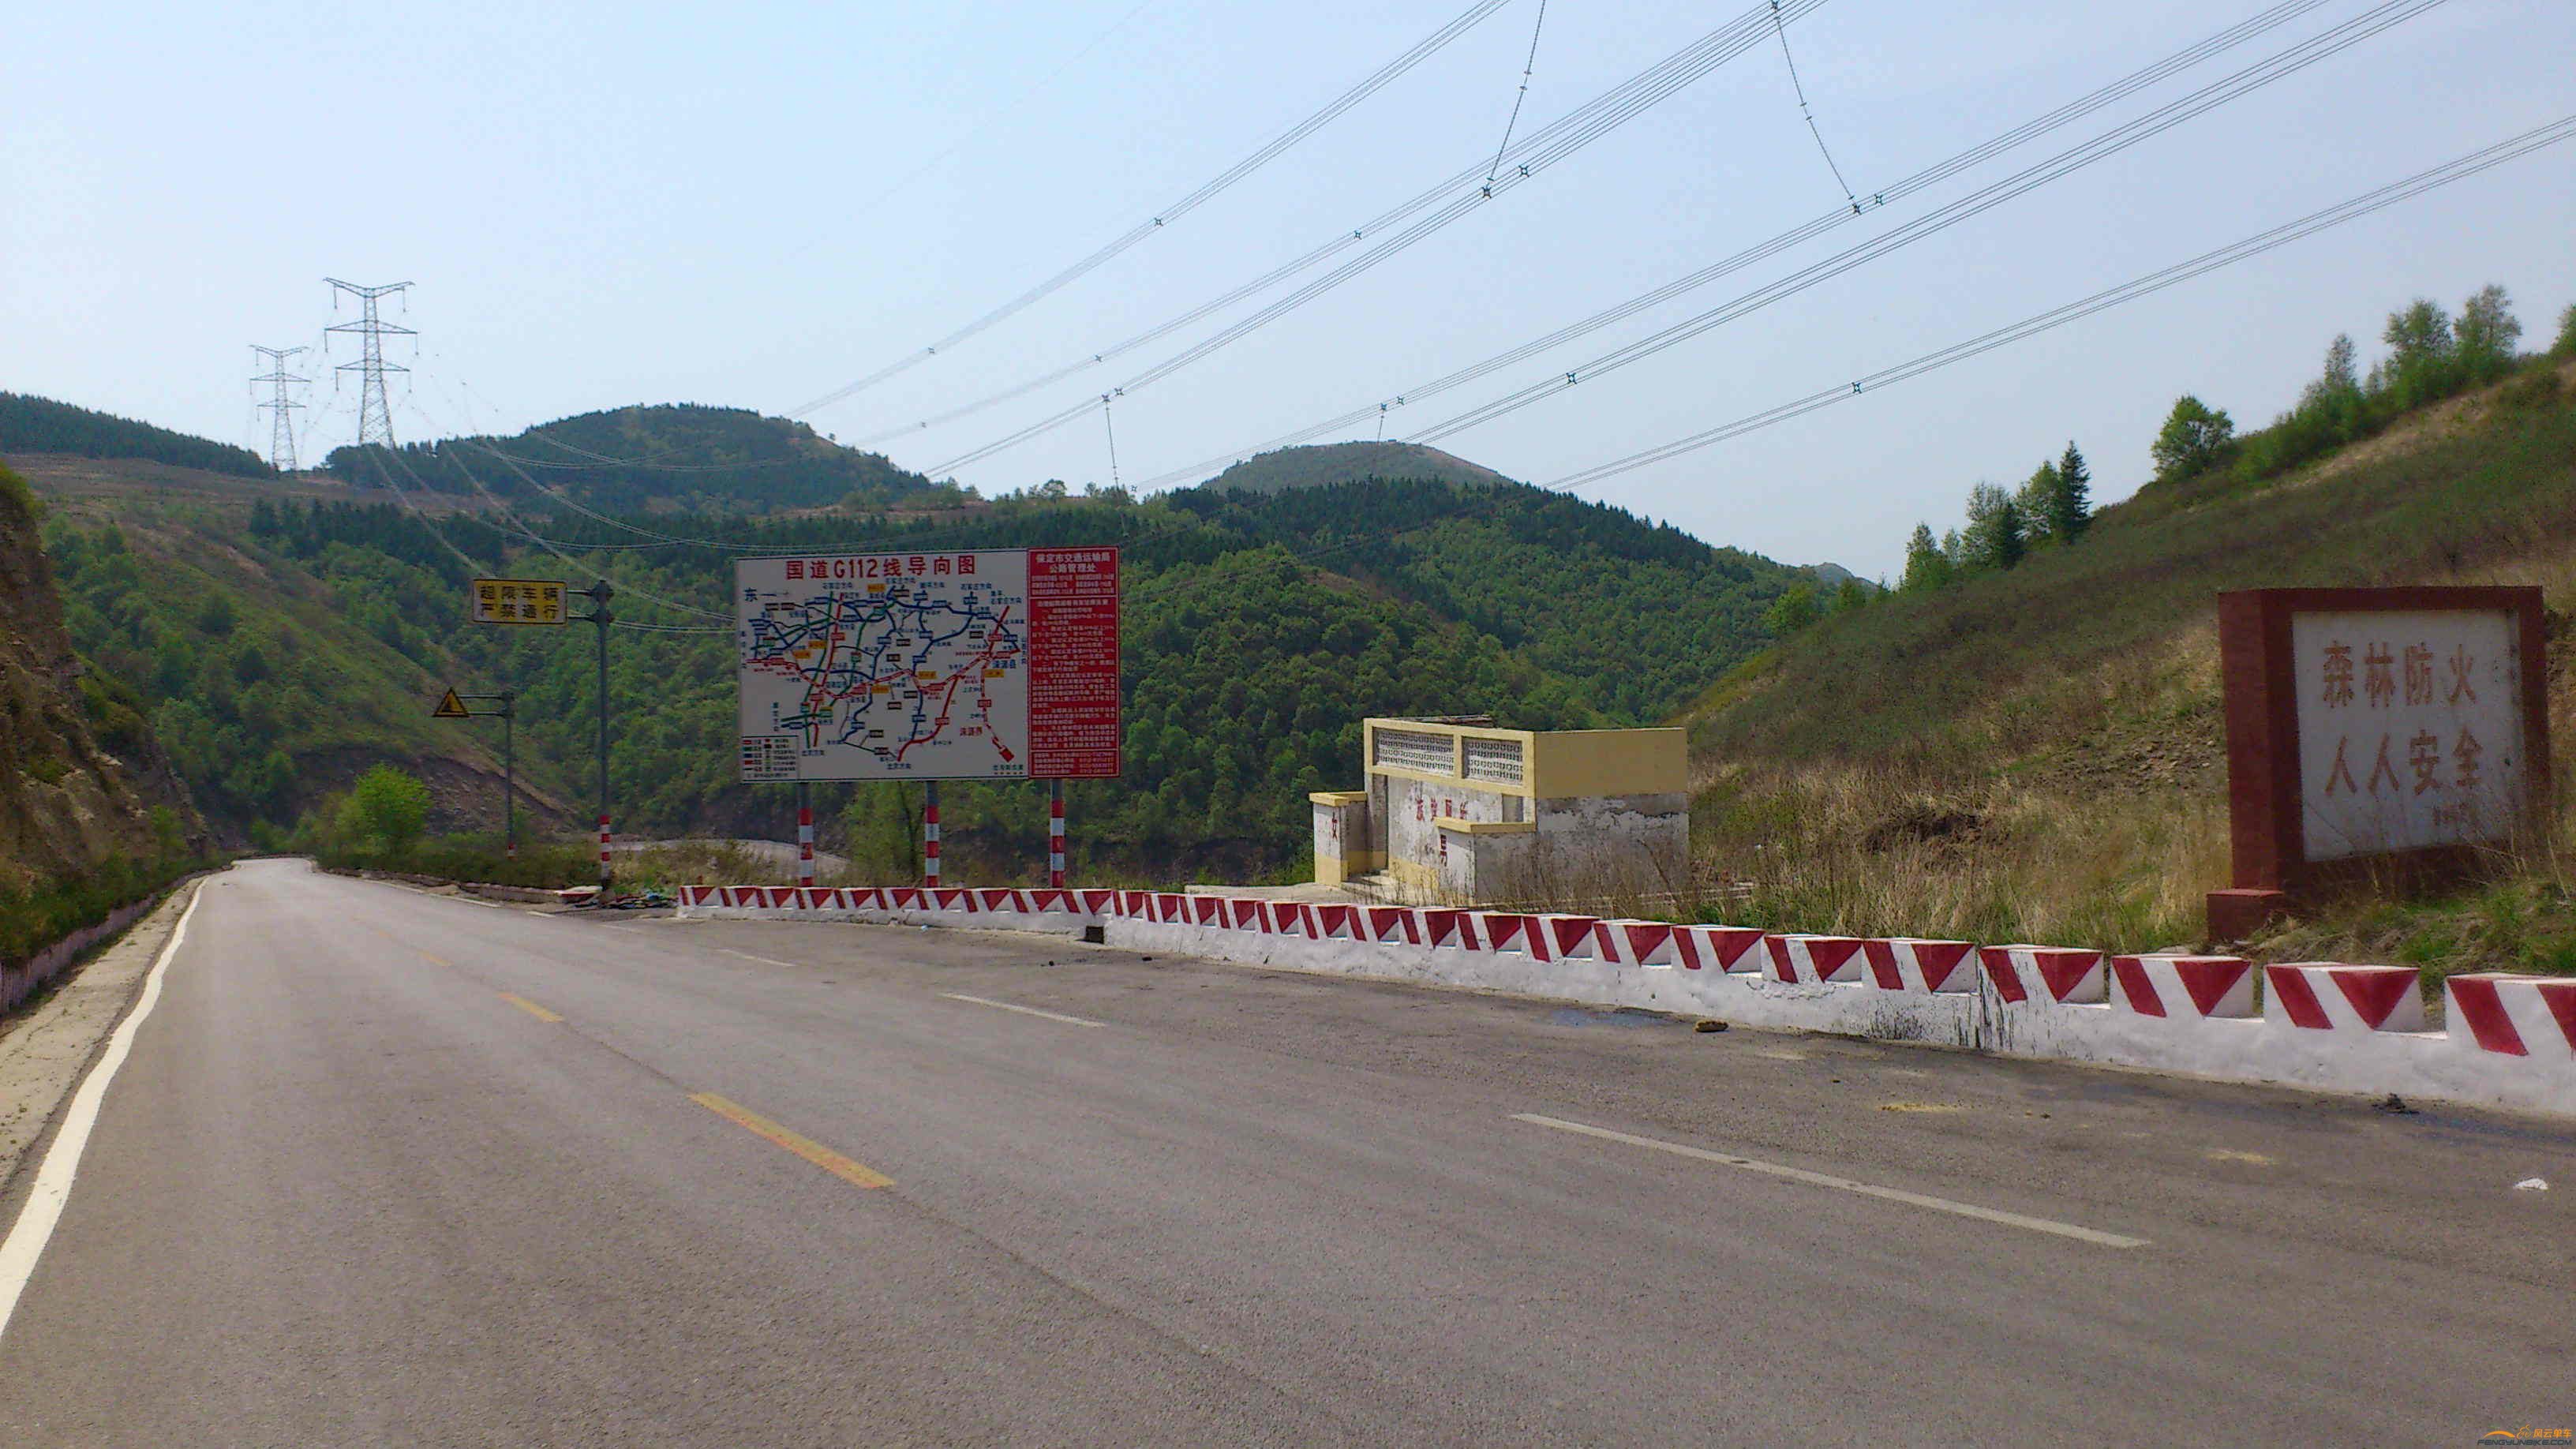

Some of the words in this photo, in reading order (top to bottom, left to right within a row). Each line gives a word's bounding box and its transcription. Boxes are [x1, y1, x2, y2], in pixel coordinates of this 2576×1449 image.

[786, 555, 975, 580] 国道G112线导向图
[744, 587, 758, 602] 东
[481, 603, 559, 620] 严禁通行
[2323, 639, 2477, 708] 森林防火
[2324, 727, 2484, 797] 人人安全
